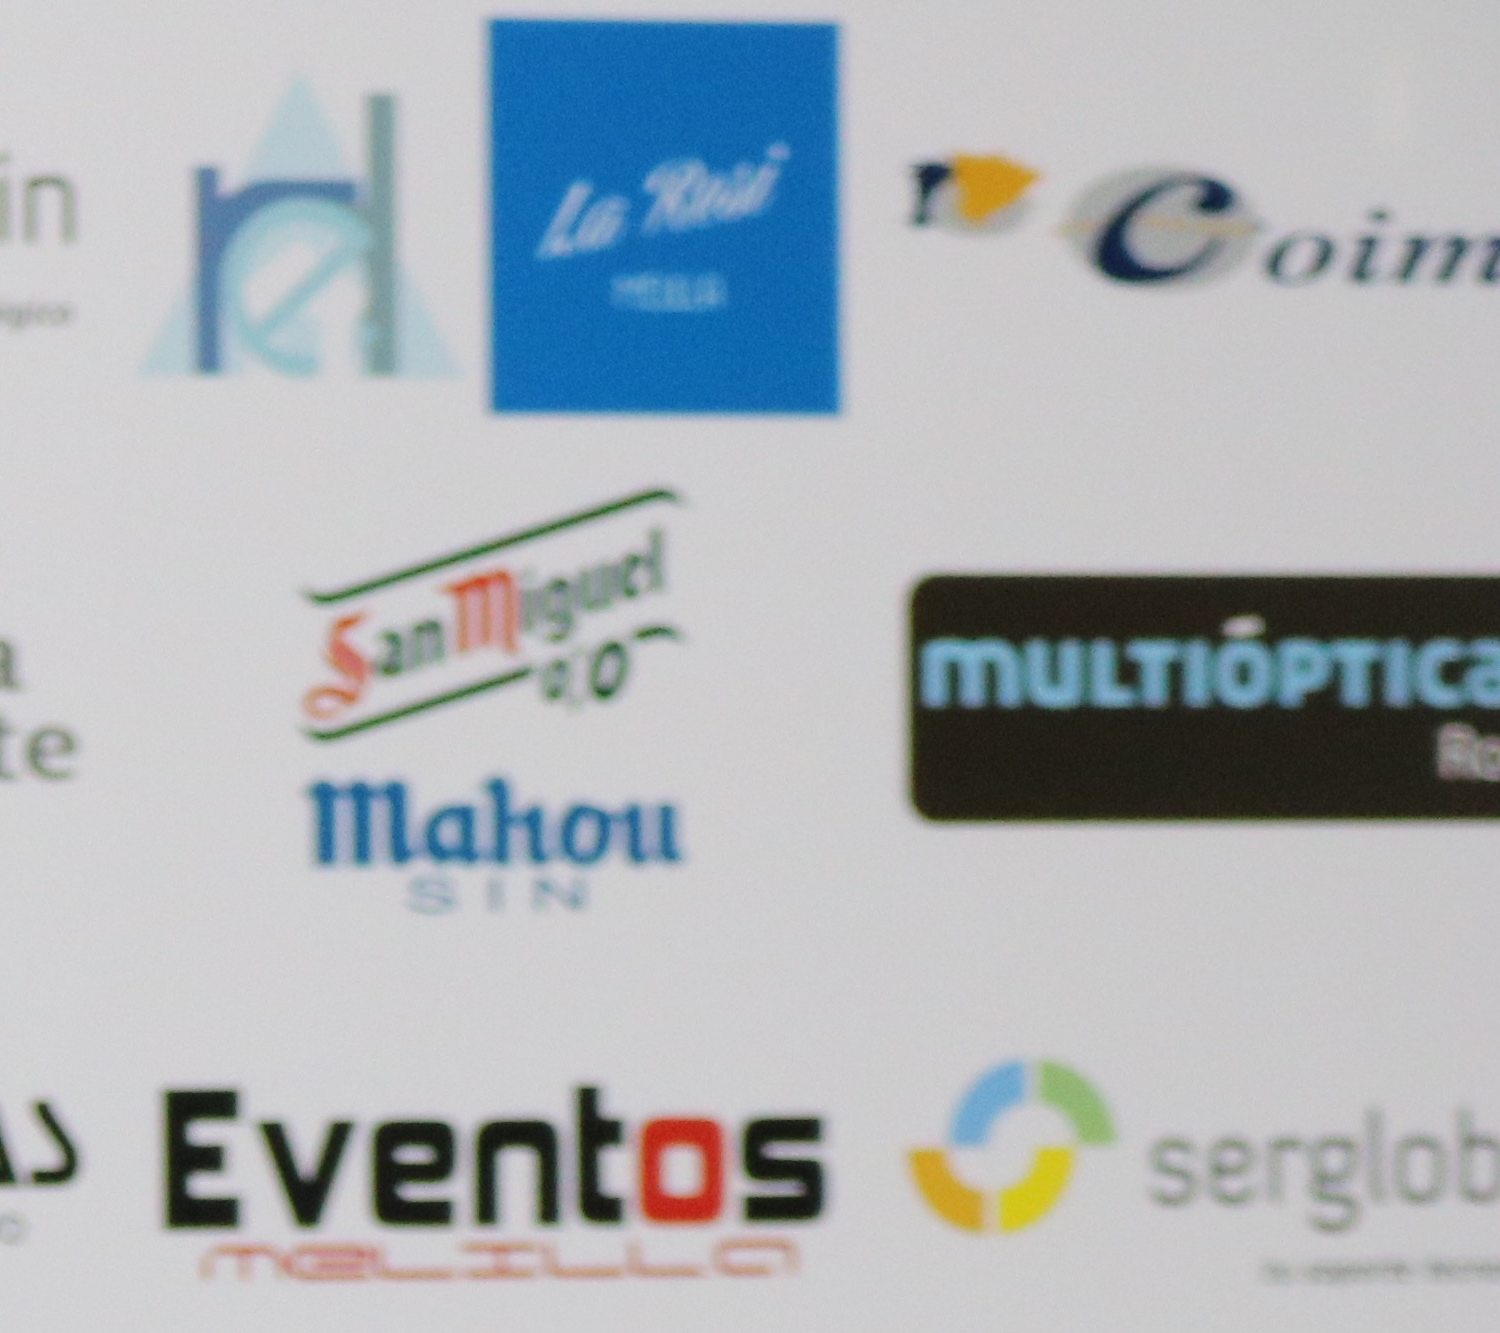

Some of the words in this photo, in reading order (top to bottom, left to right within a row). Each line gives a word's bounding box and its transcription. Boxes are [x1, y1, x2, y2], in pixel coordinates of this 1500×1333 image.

[301, 612, 445, 720] San
[440, 526, 668, 658] Miguel
[308, 776, 686, 866] Mahou
[402, 876, 592, 914] SIN
[164, 1086, 826, 1228] Eventos
